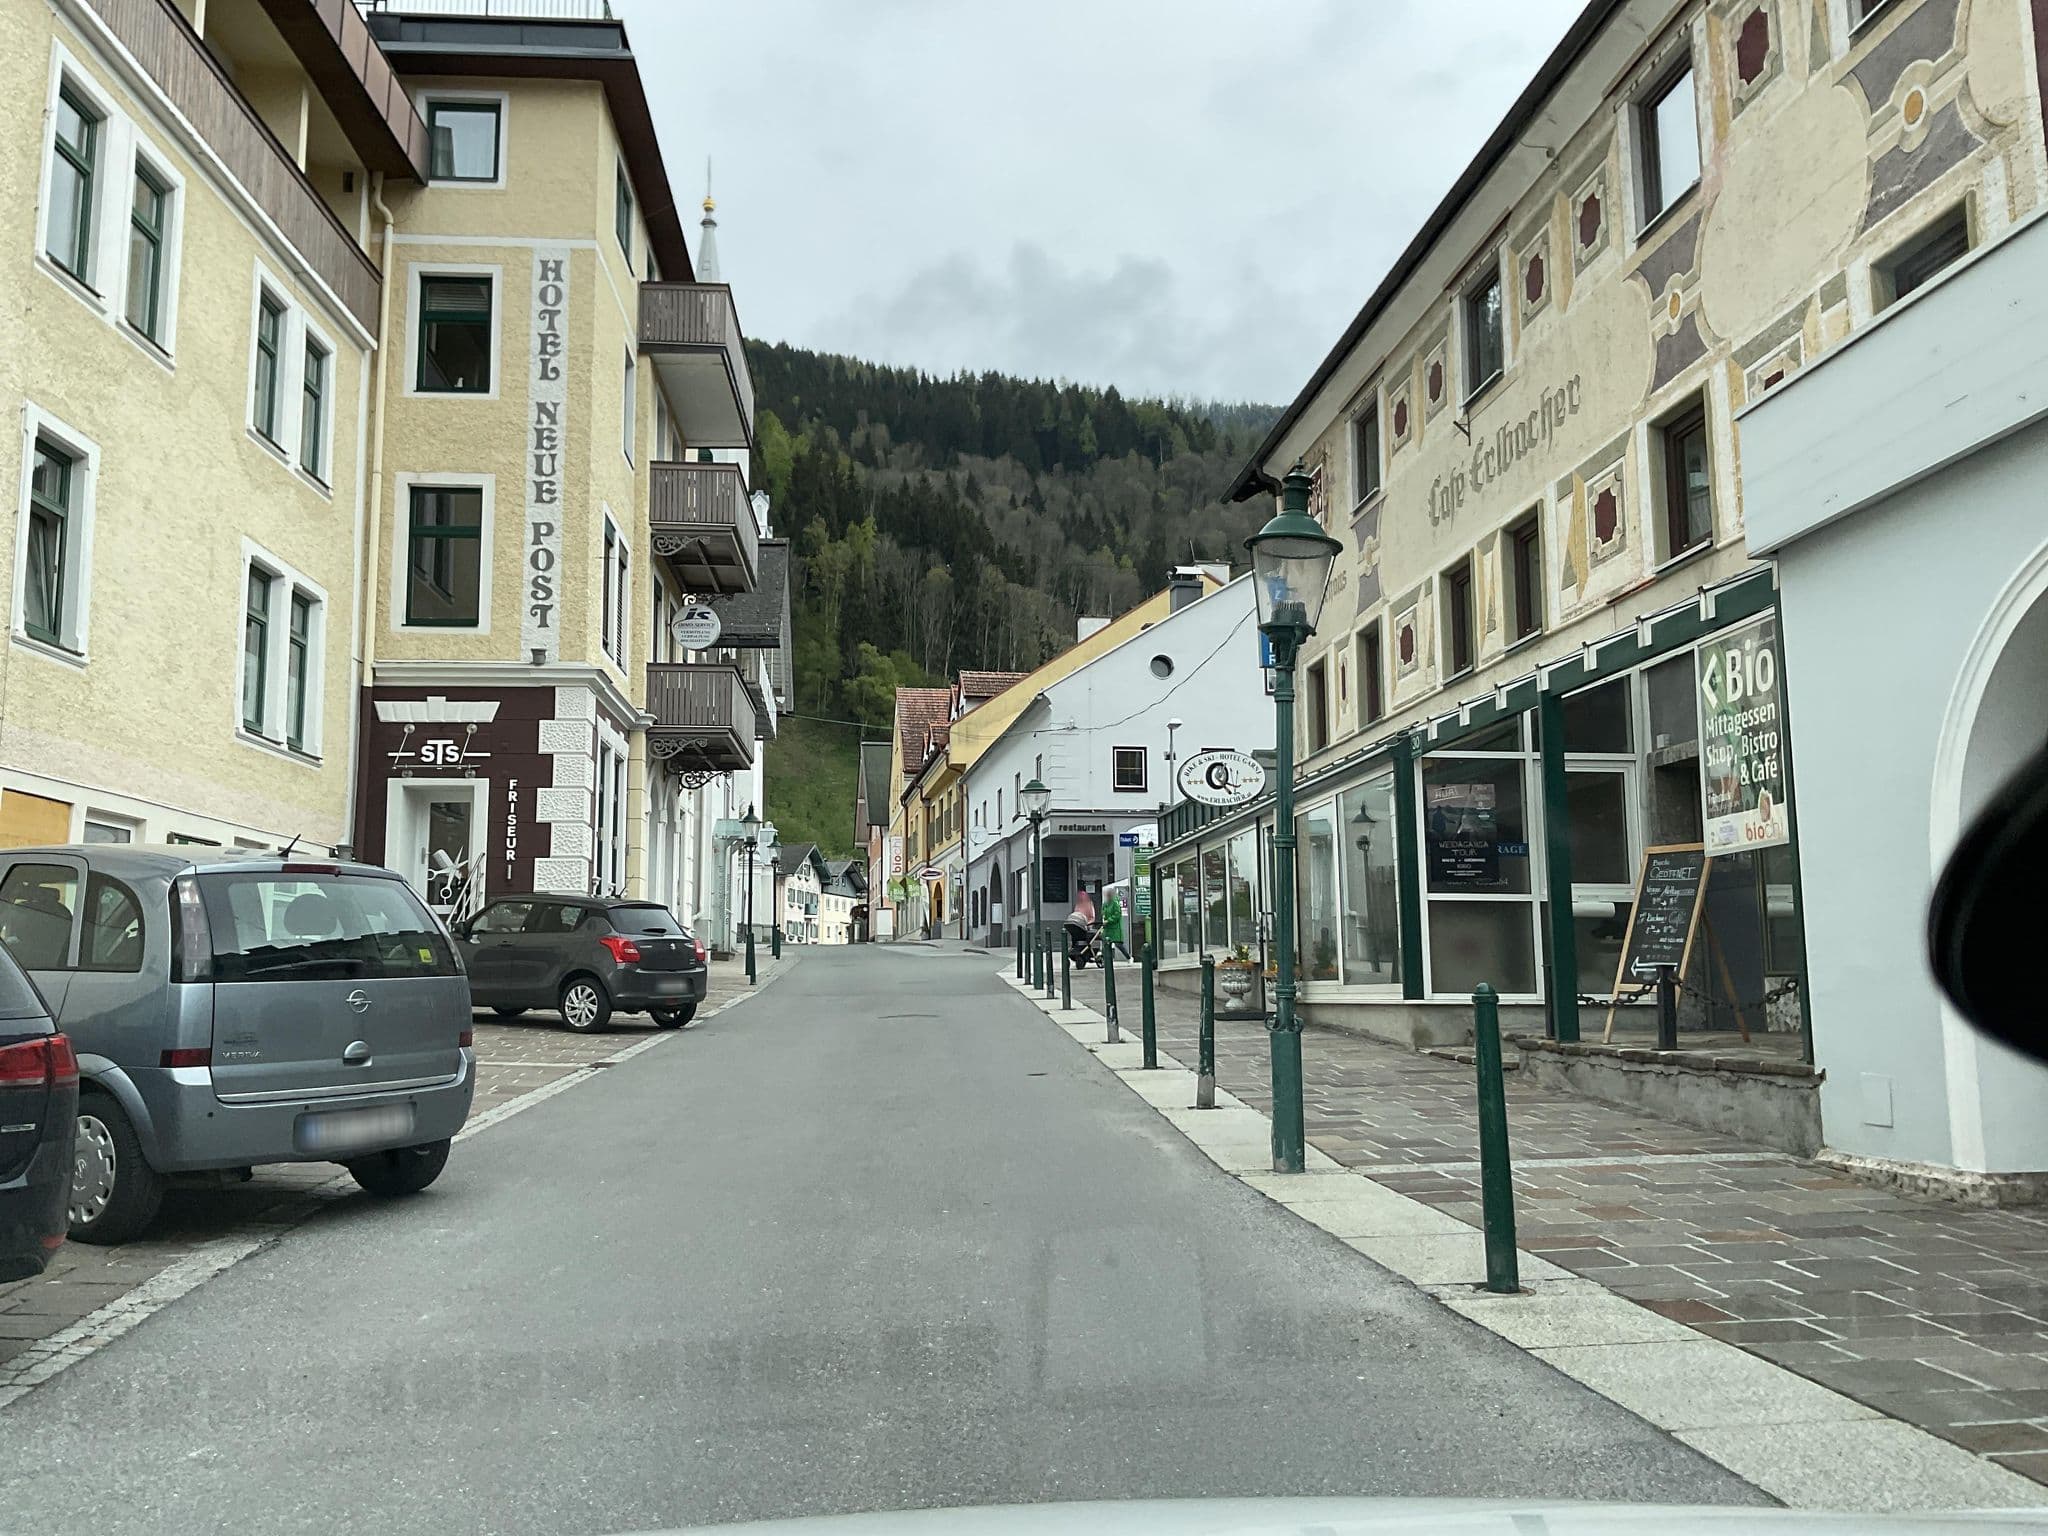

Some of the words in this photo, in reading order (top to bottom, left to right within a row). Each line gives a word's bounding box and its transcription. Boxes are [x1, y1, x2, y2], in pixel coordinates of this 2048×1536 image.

[537, 259, 564, 381] HOTEL
[531, 401, 561, 504] NEUE
[1427, 460, 1465, 530] Café
[529, 521, 555, 628] POST
[1725, 638, 1775, 704] Bio
[420, 739, 460, 768] STS
[1705, 702, 1776, 740] Mittagessen
[1706, 743, 1738, 768] Shop,
[1741, 731, 1778, 757] Bistro
[1740, 763, 1751, 786] &
[1751, 752, 1778, 783] Café
[506, 778, 518, 861] FRISEUR
[1058, 823, 1106, 832] restaurant
